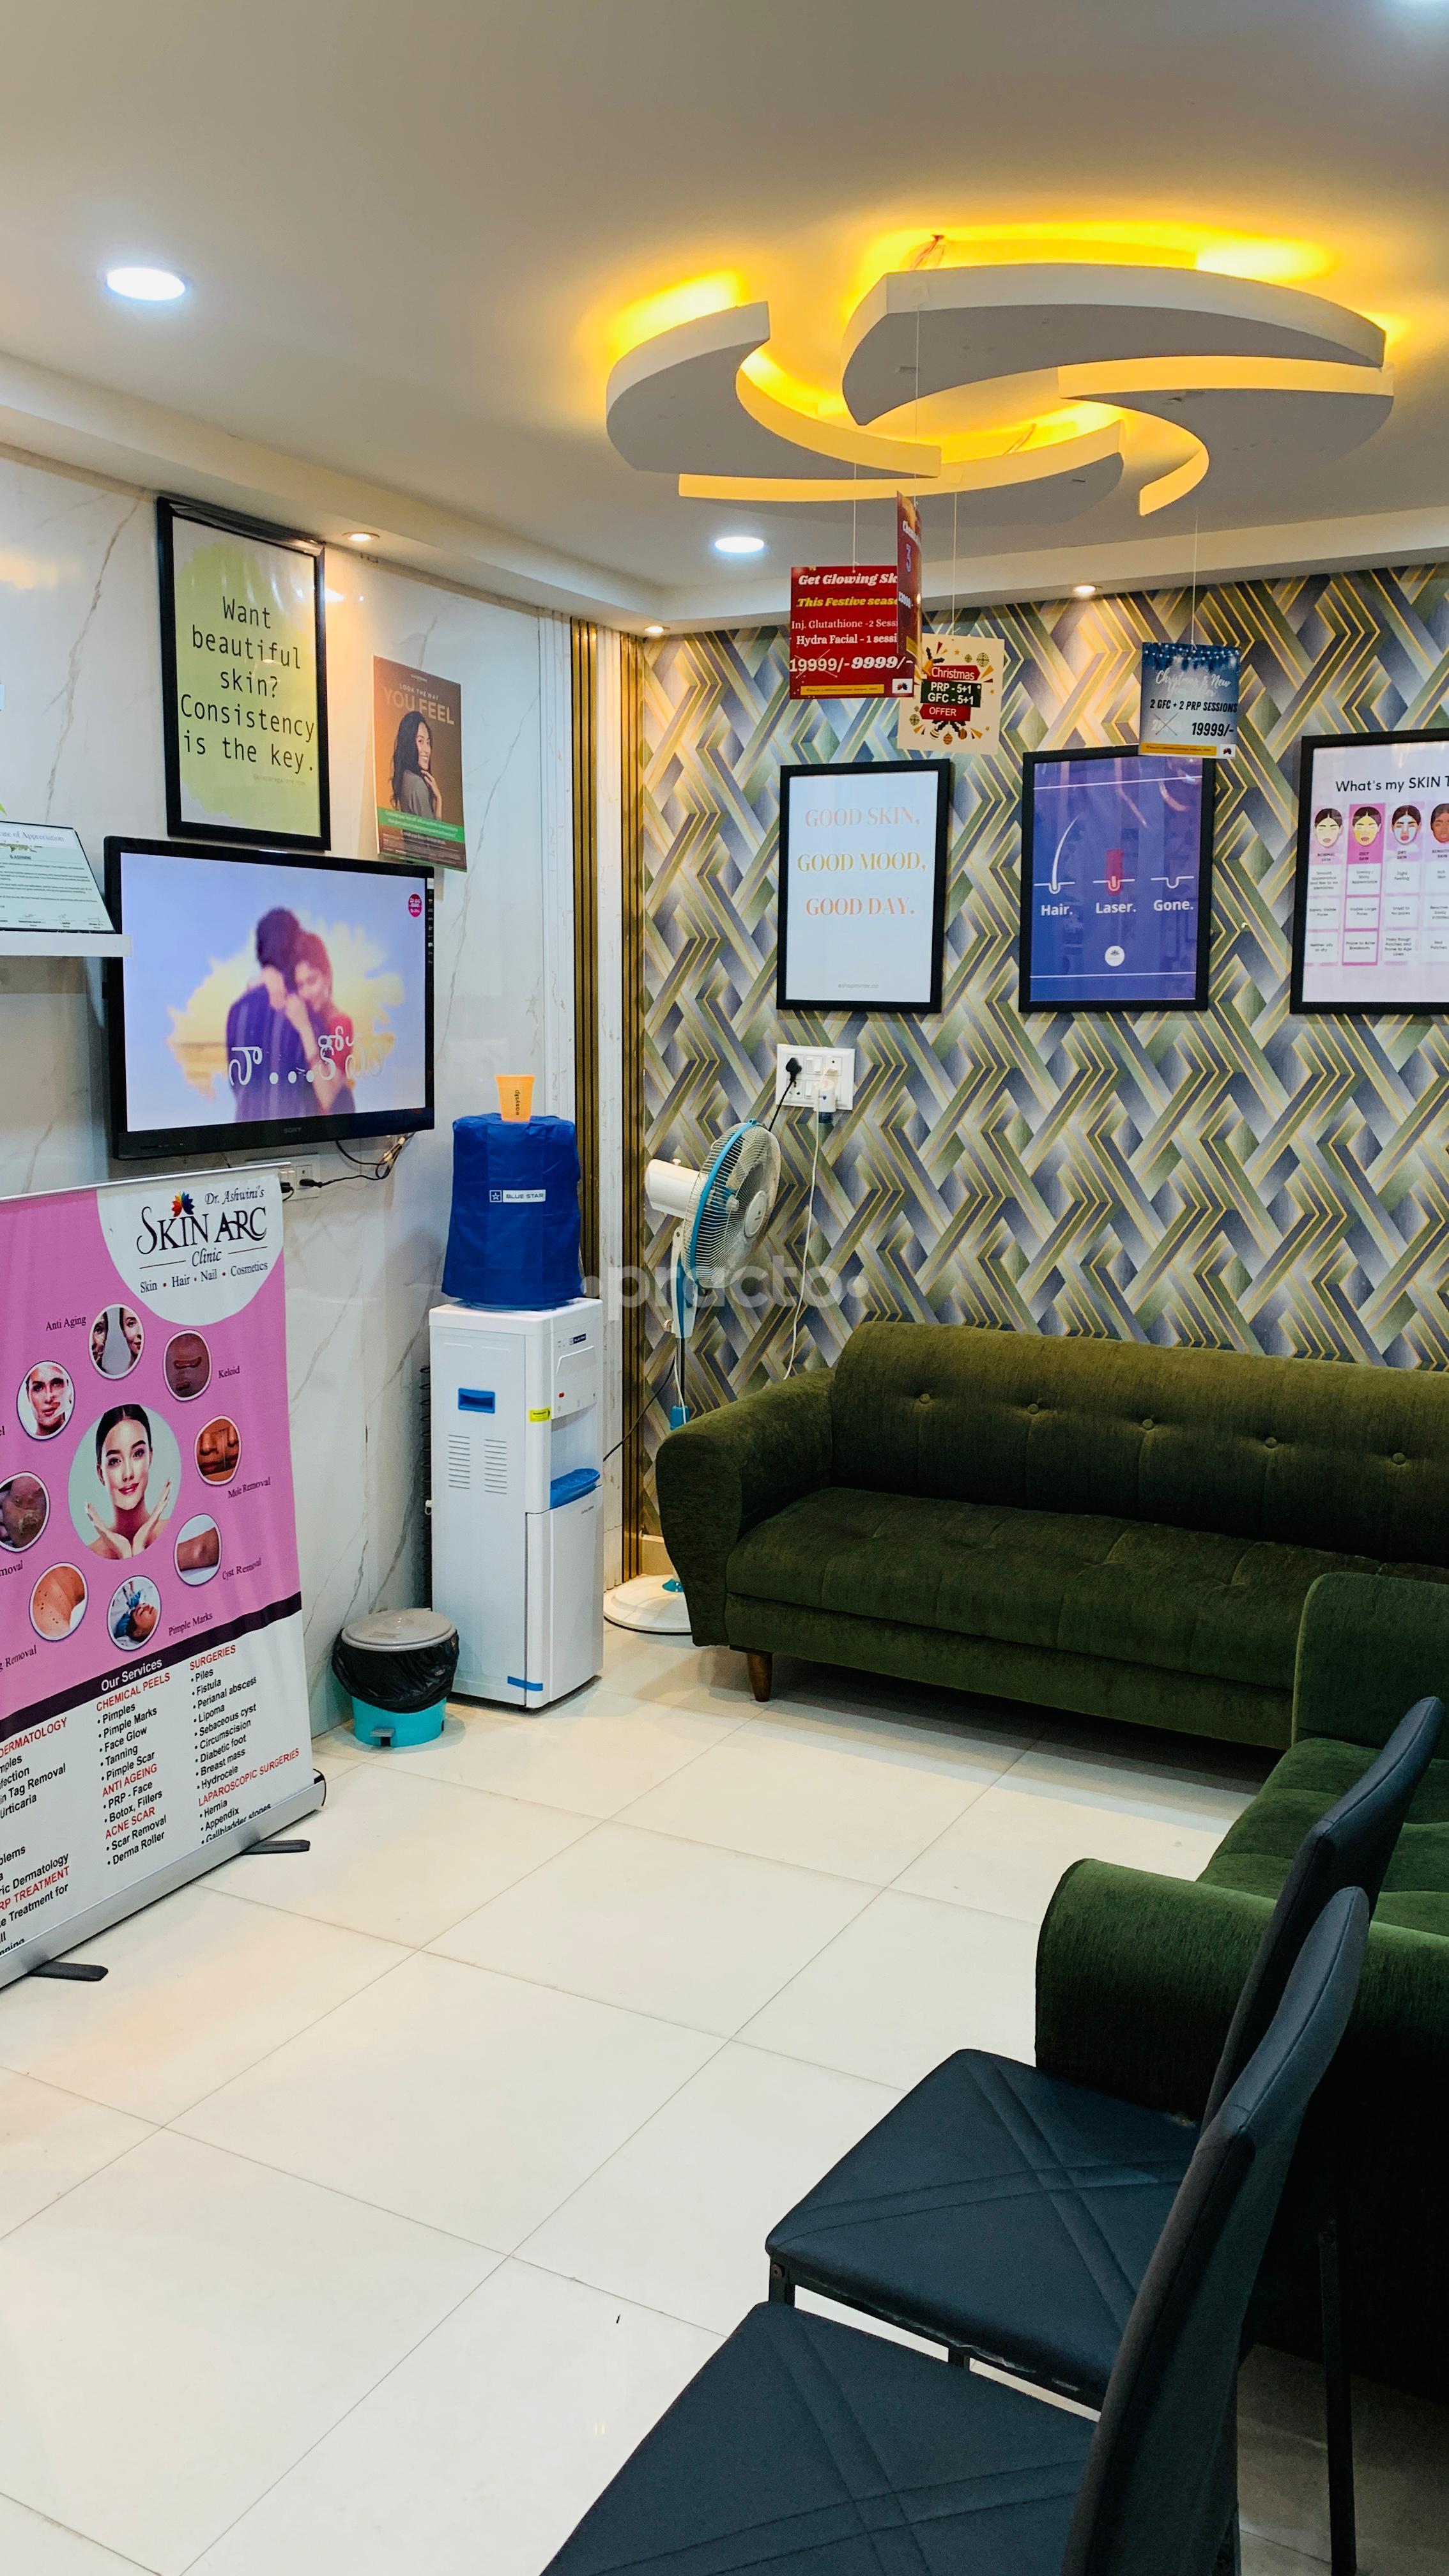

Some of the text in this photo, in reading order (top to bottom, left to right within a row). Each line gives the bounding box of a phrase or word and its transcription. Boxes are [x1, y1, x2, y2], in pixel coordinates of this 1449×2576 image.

[798, 574, 821, 586] Get
[822, 573, 879, 586] Glowing
[223, 596, 271, 629] Want
[797, 598, 824, 608] This
[825, 596, 865, 606] Festive
[792, 620, 807, 630] Inj.
[808, 619, 863, 629] Glutathione
[192, 624, 300, 669] beautiful
[796, 635, 827, 647] Hydra
[829, 633, 858, 645] Facial
[220, 668, 278, 698] skin?
[931, 666, 975, 680] Christmas
[399, 683, 440, 700] LOOK THE WAY
[928, 693, 949, 703] GFC
[957, 694, 974, 705] 5+1
[930, 682, 950, 692] PRP
[956, 683, 972, 694] 5+1
[181, 694, 314, 743] Consistency
[382, 687, 455, 725] YOU FEEL
[929, 707, 957, 716] OFFER
[1150, 699, 1155, 709] 2
[1157, 700, 1171, 709] GFC
[1179, 701, 1184, 710] 2
[1186, 702, 1201, 710] PRP
[1203, 702, 1237, 713] SESSIONS
[1192, 722, 1234, 737] 19999/-
[184, 730, 312, 774] is the key.
[1335, 780, 1382, 792] What's
[1385, 781, 1405, 793] my
[1408, 776, 1441, 788] SKIN
[804, 806, 921, 828] GOOD SKIN,
[797, 852, 927, 872] GOOD MOOD,
[806, 897, 915, 916] GOOD DAY.
[1041, 899, 1194, 916] Hair. Laser. Gone.
[204, 1185, 264, 1205] Dr. Ashwini's
[136, 1206, 267, 1255] SKIN ARC
[192, 1248, 222, 1267] Clinic
[140, 1261, 268, 1294] Skin Hair Nail Cosmetics
[45, 1315, 87, 1331] Anti Aging
[218, 1365, 241, 1379] Keloid
[242, 1476, 271, 1494] Removal
[222, 1558, 262, 1581] Cyst Removal
[168, 1612, 213, 1636] Pimple Marks
[4, 1644, 37, 1667] Removal
[190, 1644, 236, 1671] SURGERIES
[101, 1659, 162, 1692] Our Services
[195, 1668, 214, 1682] Piles
[196, 1678, 222, 1696] Fistula
[96, 1672, 171, 1712] CHEMICAL PEELS
[197, 1676, 257, 1710] Perianal abscess
[102, 1703, 136, 1724] Pimples
[103, 1707, 158, 1738] Pimple Marks
[199, 1704, 225, 1723] Lipoma
[199, 1703, 257, 1736] Sebaceous cyst
[104, 1726, 148, 1752] Face Glow
[199, 1719, 251, 1749] Circumscision
[105, 1745, 139, 1767] Tanning
[200, 1734, 247, 1763] Diabetic foot
[106, 1751, 155, 1781] Pimple Scar
[201, 1748, 246, 1776] Breast mass
[0, 1767, 30, 1790] fection
[8, 1785, 26, 1798] Tag
[27, 1763, 66, 1790] Removal
[102, 1763, 158, 1798] ANTI AGEING
[199, 1747, 300, 1807] LAPAROSCOPIC SURGERIES
[201, 1765, 239, 1790] Hydrocele
[0, 1794, 37, 1819] Urticaria
[108, 1792, 126, 1809] PRP
[132, 1781, 153, 1796] Face
[109, 1790, 163, 1823] Botox, Fillers
[204, 1798, 227, 1818] Hernia
[205, 1806, 240, 1832] Appendix
[105, 1806, 156, 1839] ACNE SCAR
[111, 1814, 167, 1850] Scar Removal
[112, 1831, 165, 1866] Derma Roller
[13, 1853, 69, 1890] Dermatology
[13, 1866, 70, 1903] TREATMENT
[9, 1883, 69, 1922] Treatment for
